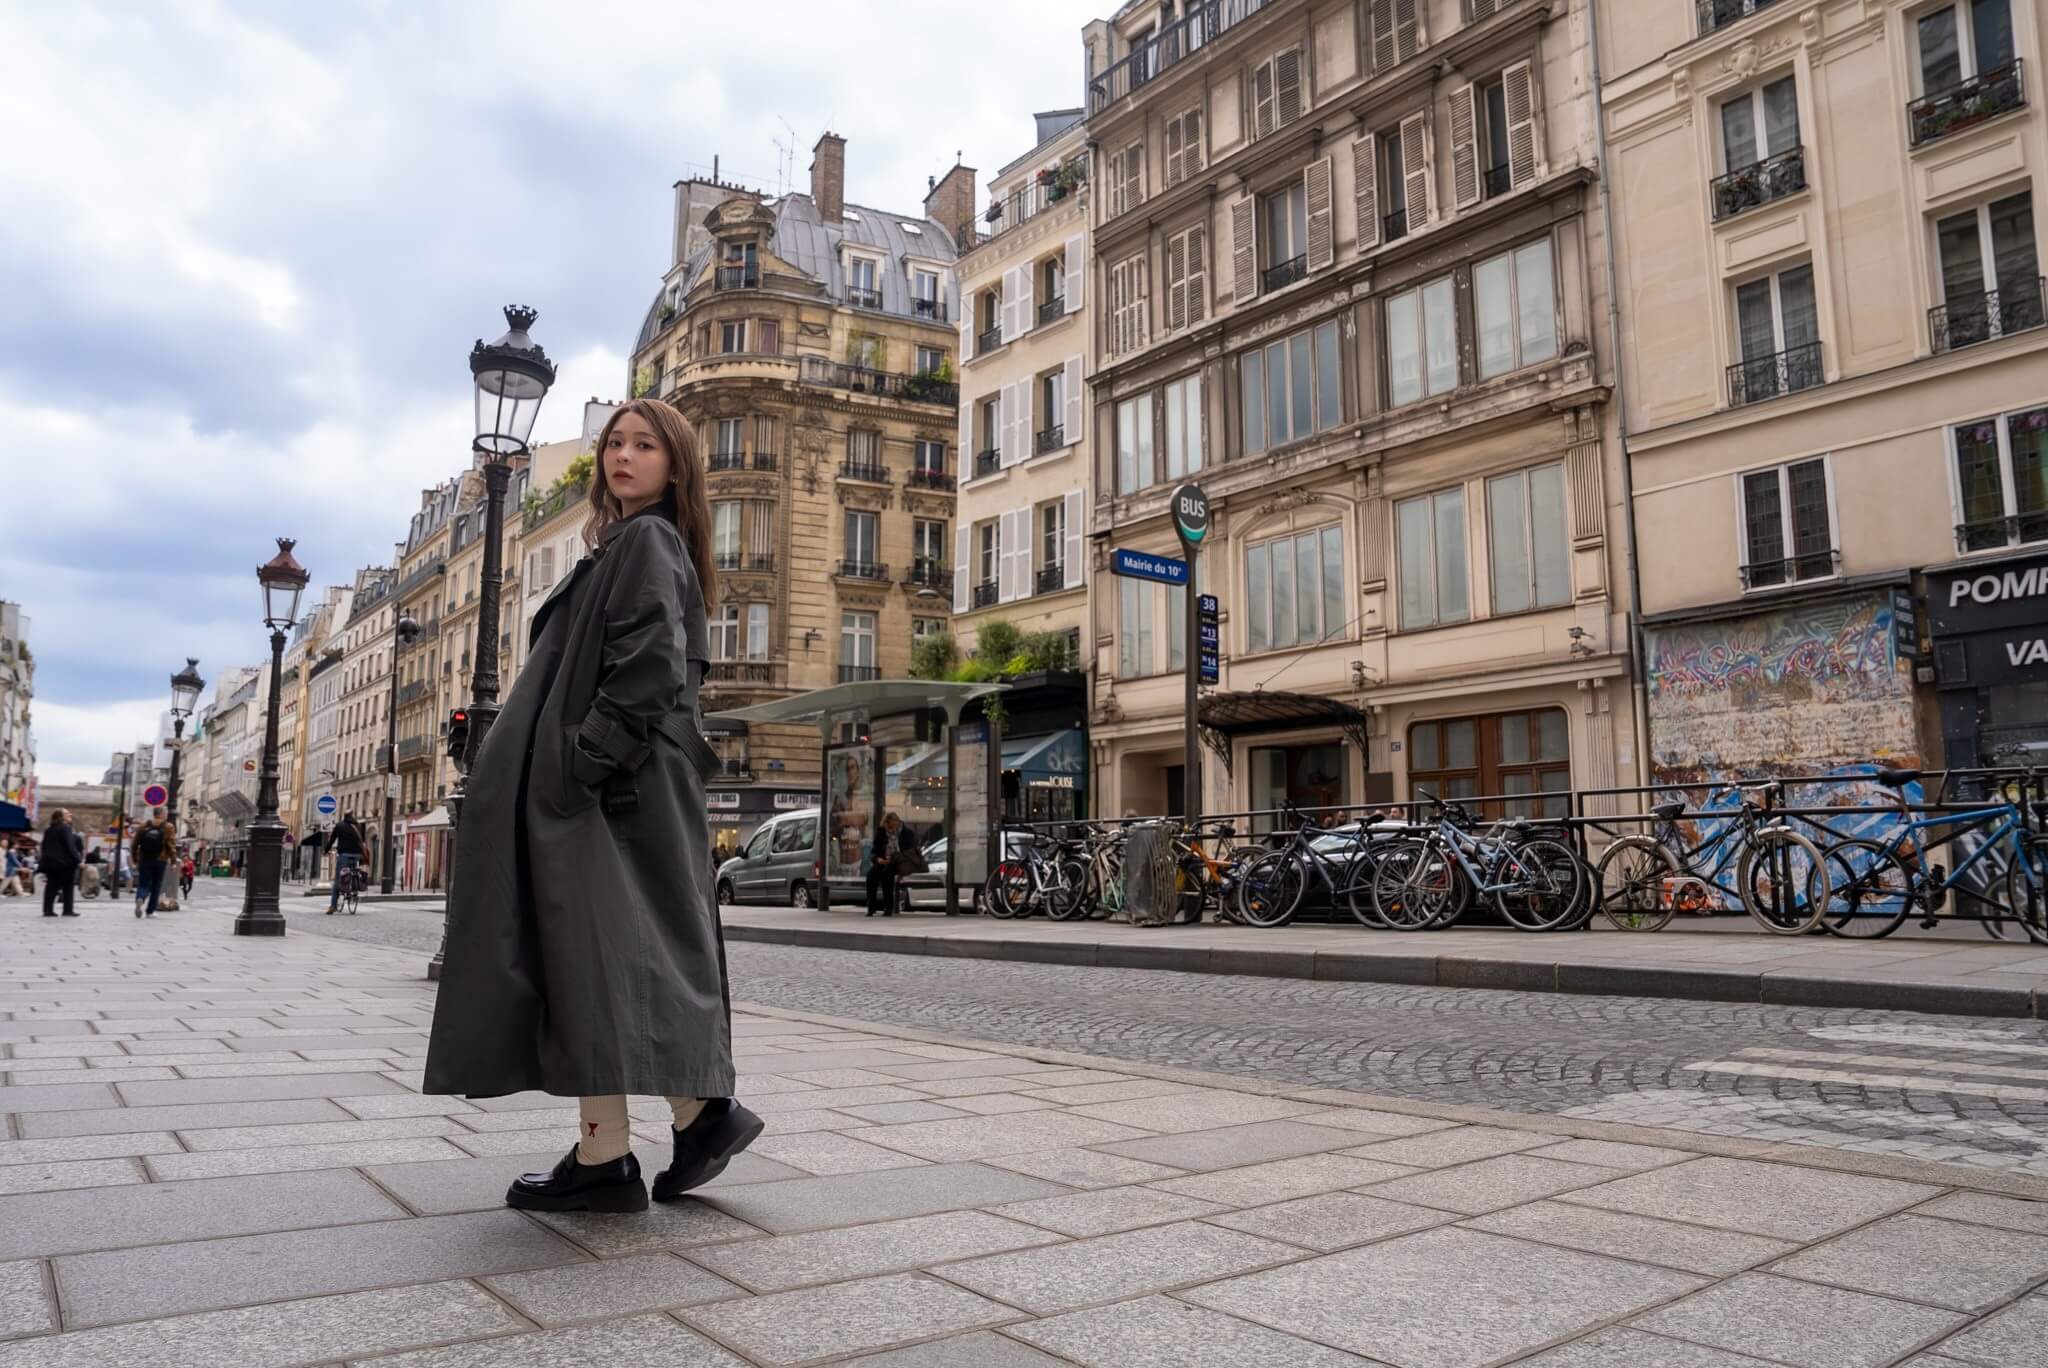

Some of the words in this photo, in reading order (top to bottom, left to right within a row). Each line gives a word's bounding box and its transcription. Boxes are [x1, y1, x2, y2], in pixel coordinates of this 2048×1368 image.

[1180, 496, 1205, 518] BUS
[1123, 556, 1153, 572] Mairie
[1154, 562, 1166, 574] du
[1202, 597, 1216, 611] 38
